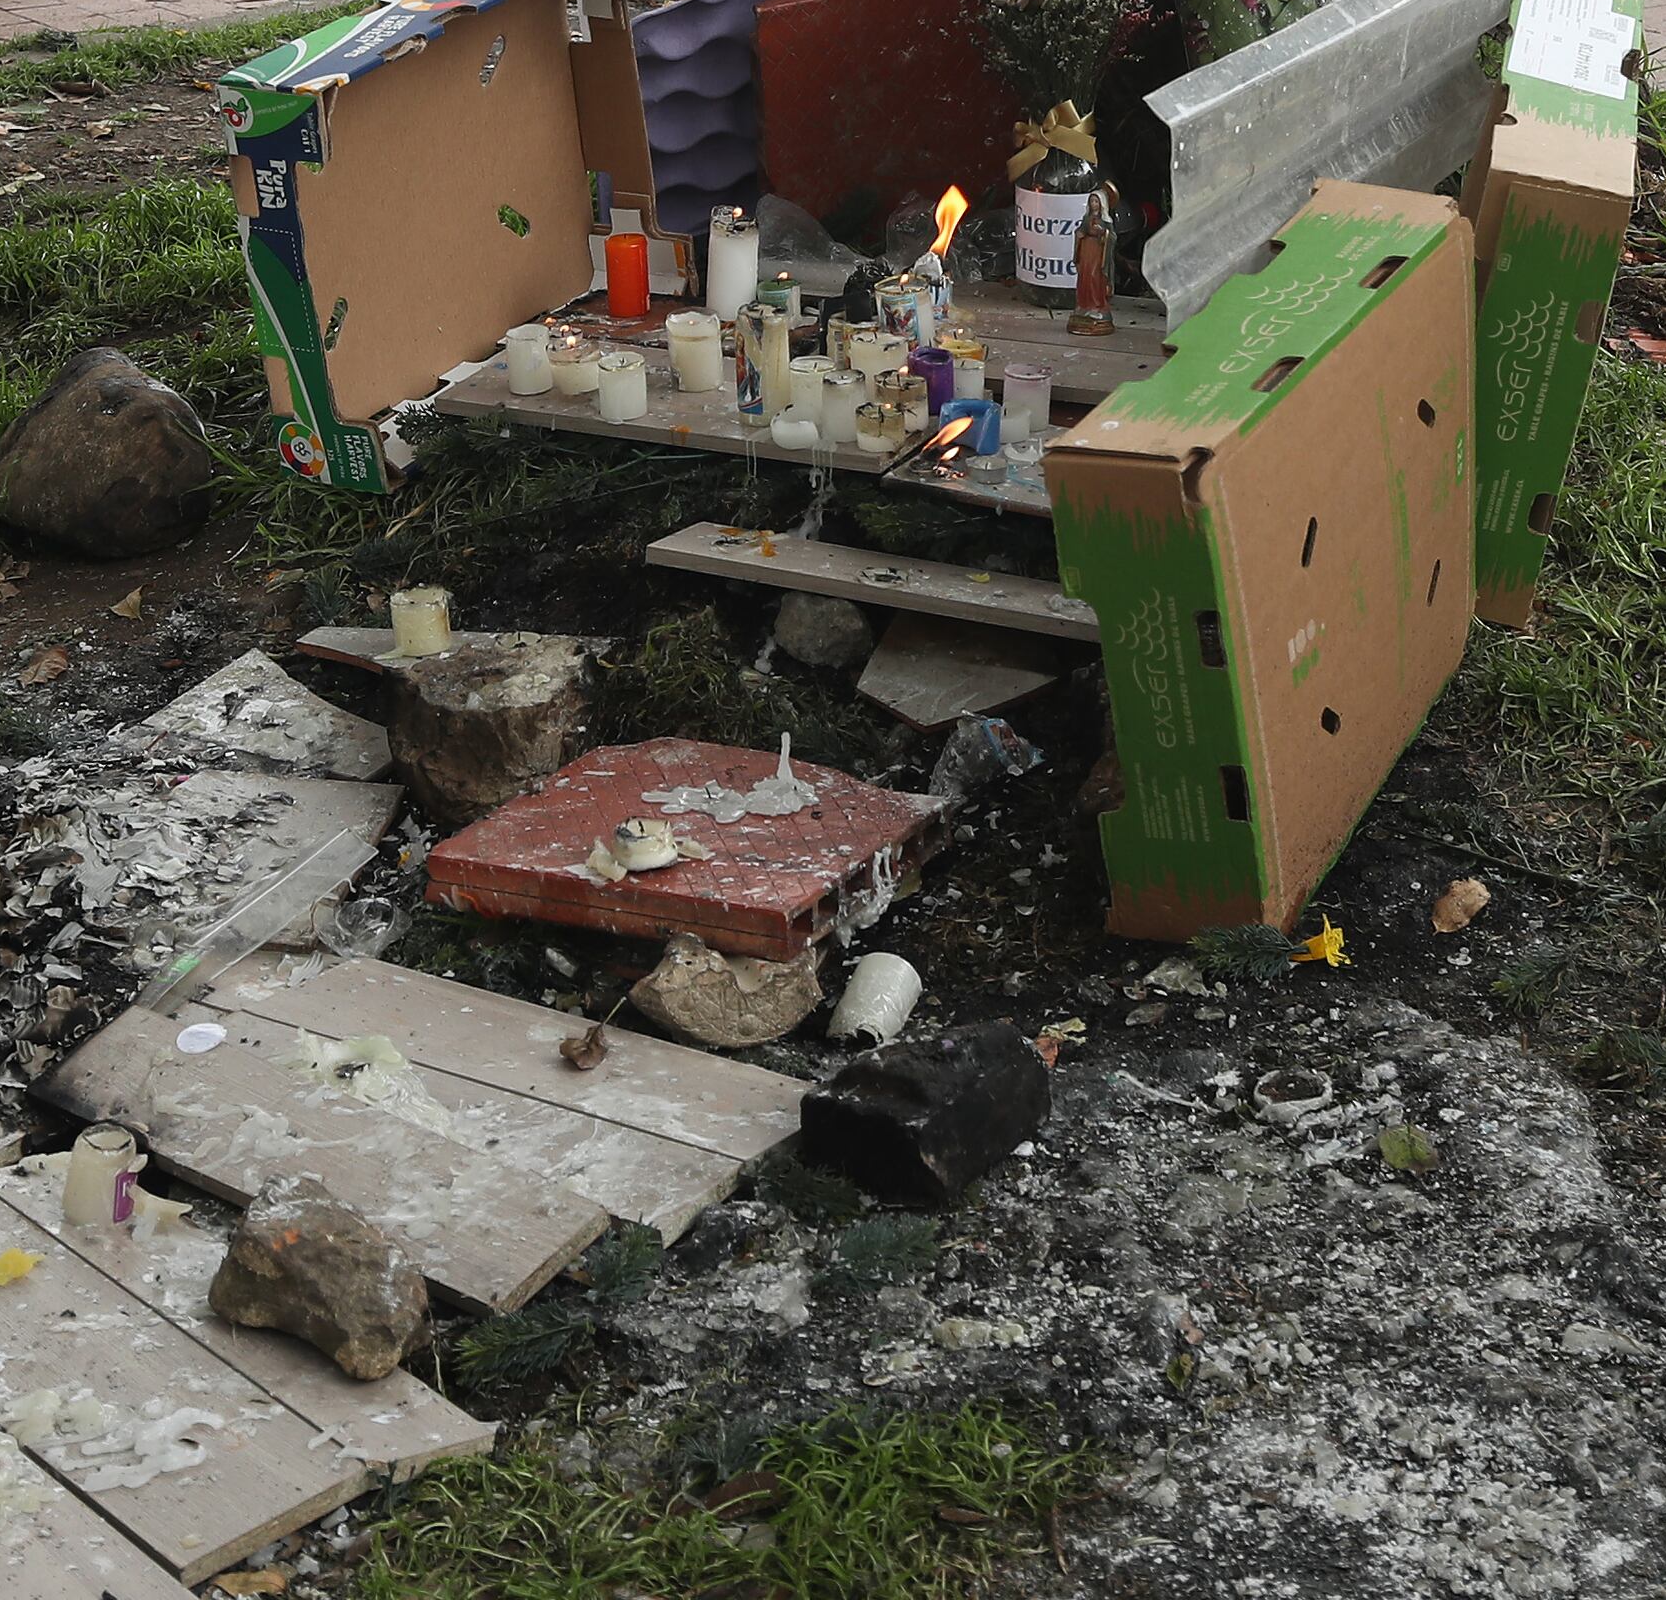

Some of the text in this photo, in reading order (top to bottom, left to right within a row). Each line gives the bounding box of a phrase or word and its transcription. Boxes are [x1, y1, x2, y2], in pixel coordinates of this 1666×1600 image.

[255, 168, 276, 209] KIN
[269, 159, 287, 209] Pura
[1533, 381, 1550, 415] GRAPES
[1556, 300, 1570, 328] TABLE
[343, 434, 361, 482] HARVEST
